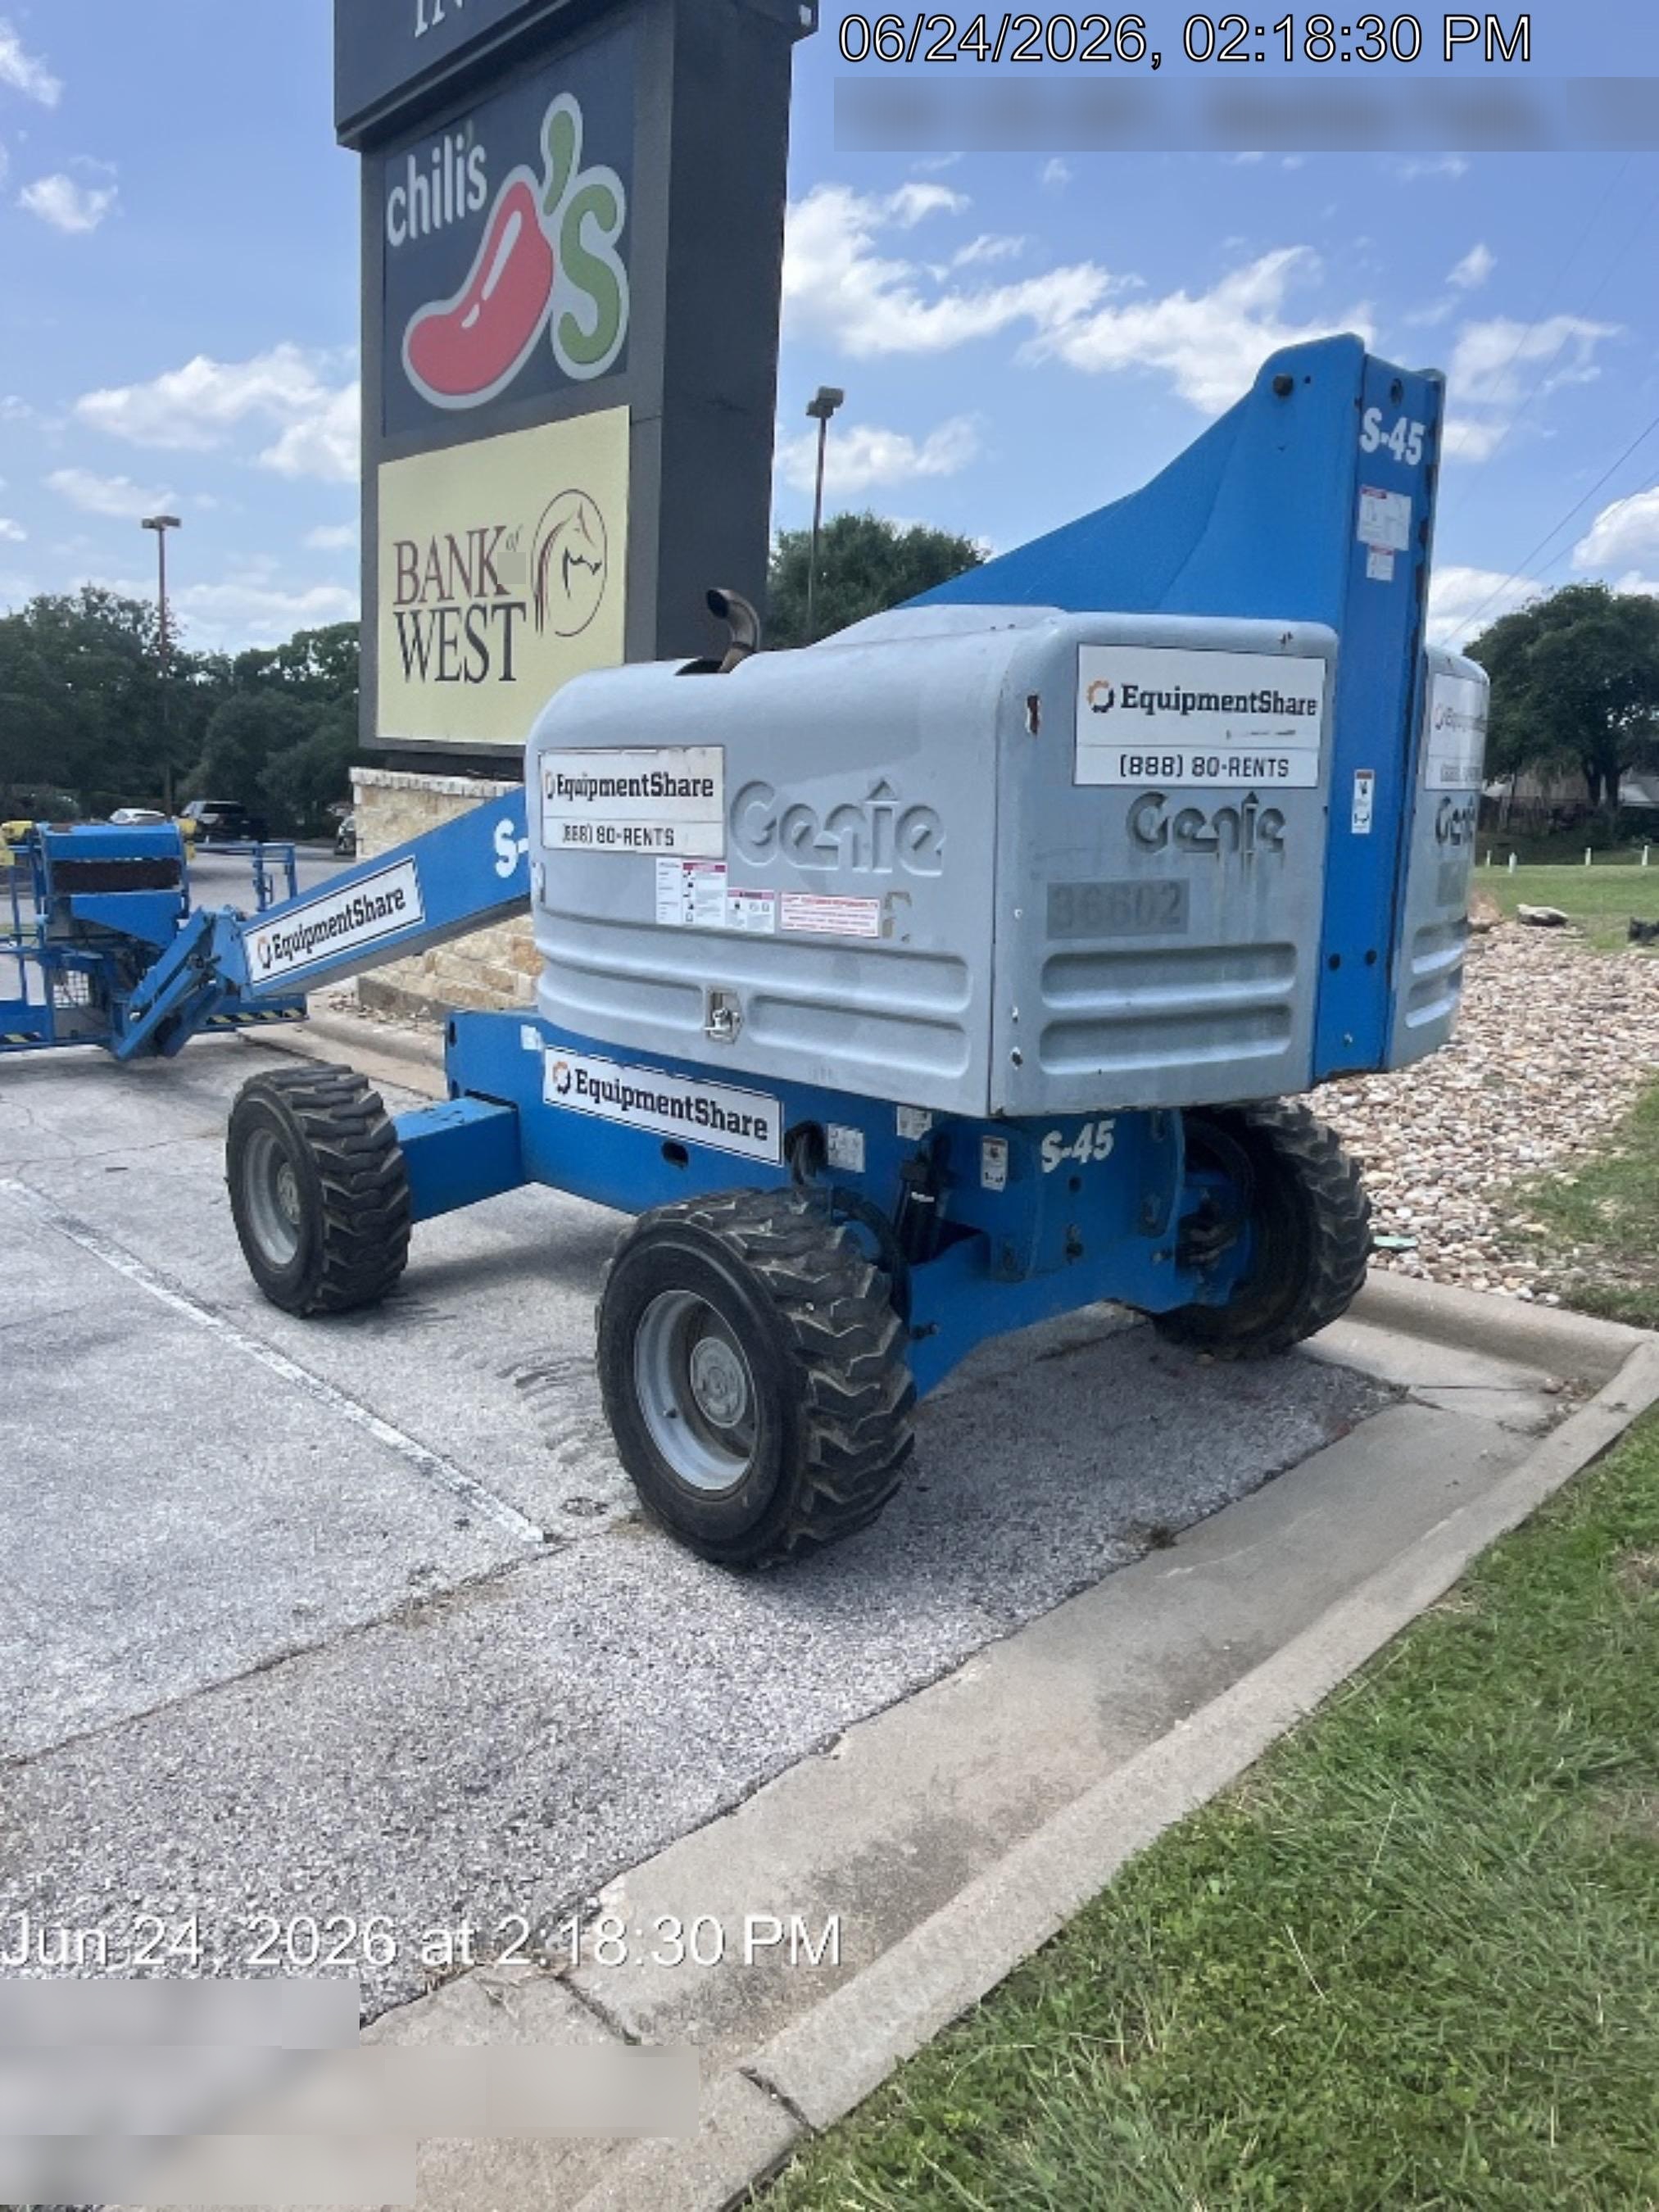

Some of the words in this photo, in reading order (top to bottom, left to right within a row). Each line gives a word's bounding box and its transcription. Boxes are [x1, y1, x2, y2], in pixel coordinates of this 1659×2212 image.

[1359, 407, 1426, 465] S-45
[392, 525, 511, 605] BANK
[392, 601, 527, 684] WEST
[1120, 683, 1317, 716] EquipmentShare
[556, 770, 714, 802] EquipmentShare
[1120, 754, 1184, 778] (888)
[1191, 755, 1290, 778] 80-RENTS
[596, 826, 674, 846] 80-RENTS
[729, 778, 947, 877] Genie
[1127, 791, 1286, 854] Genie
[271, 886, 406, 962] EquipmentShare
[574, 1068, 768, 1141] EquipmentShare
[1041, 1119, 1115, 1173] S-45
